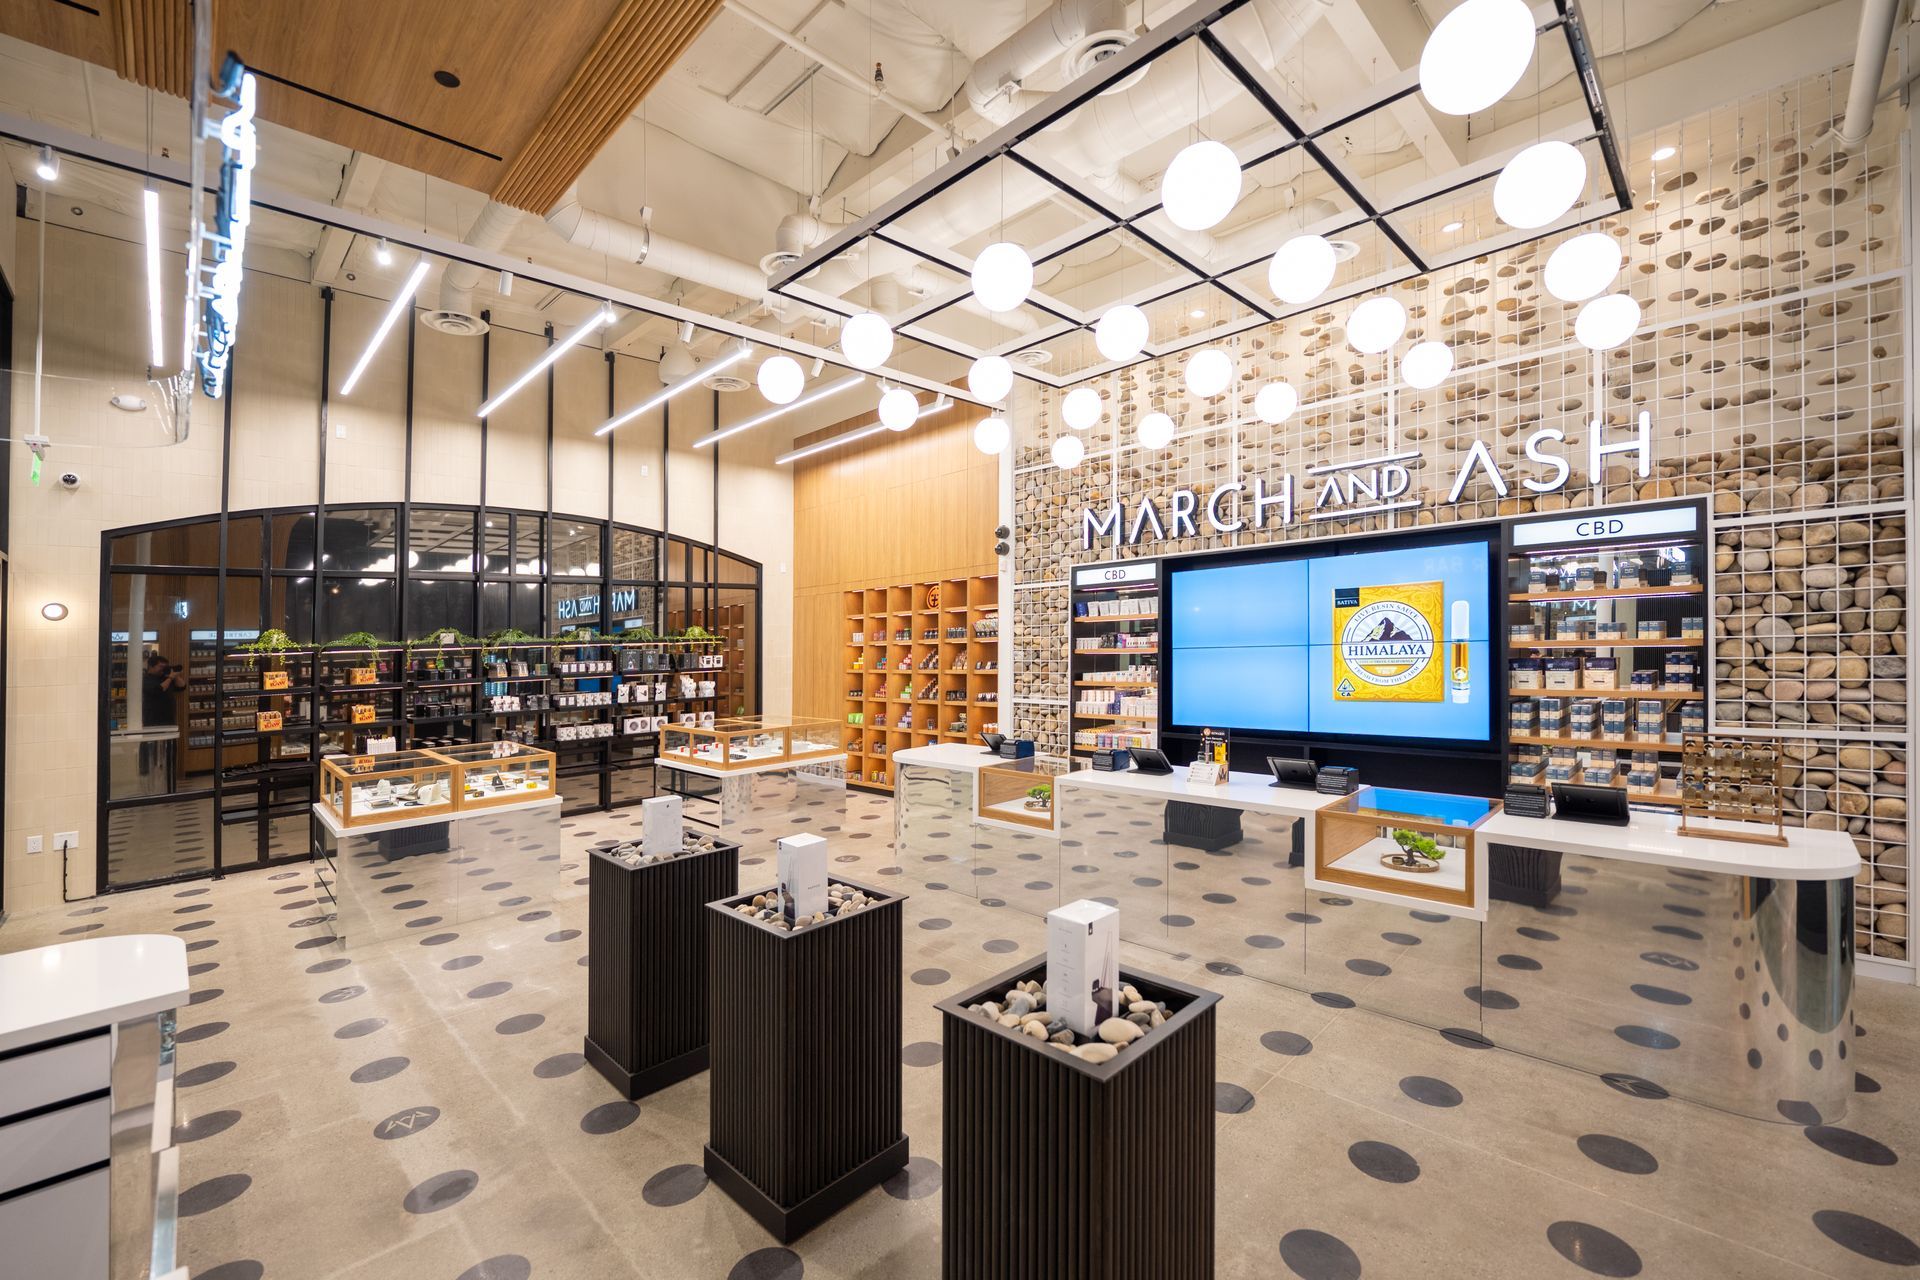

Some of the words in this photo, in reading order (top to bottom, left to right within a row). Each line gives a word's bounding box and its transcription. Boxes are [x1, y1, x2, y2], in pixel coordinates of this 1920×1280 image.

[1083, 473, 1295, 550] MARCH
[1317, 464, 1412, 508] AND
[1448, 410, 1652, 503] ASH
[1576, 519, 1624, 537] CBD
[1104, 569, 1126, 581] CBD
[1337, 598, 1358, 606] SATIVA
[1354, 609, 1369, 622] LIVE
[1371, 603, 1394, 611] RESIN
[1348, 644, 1427, 656] HIMALAYA
